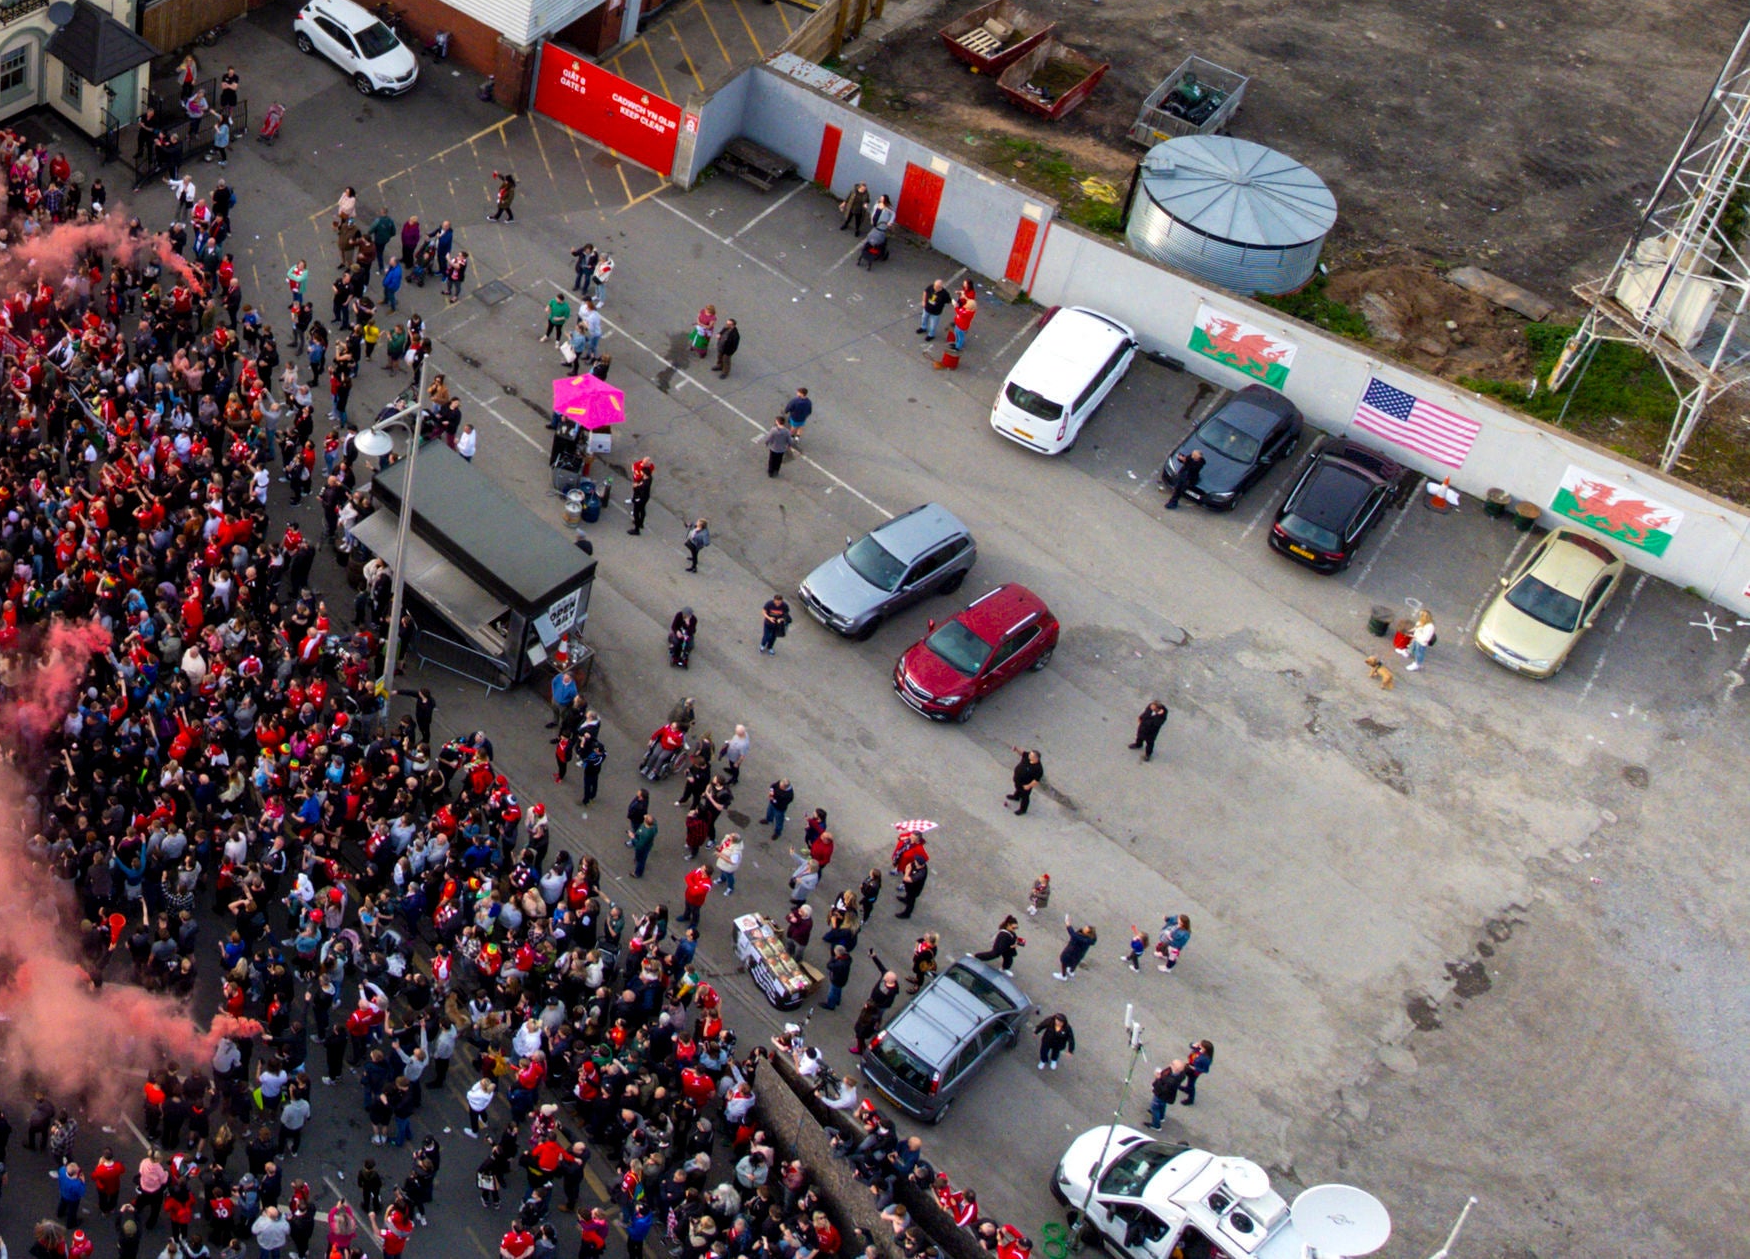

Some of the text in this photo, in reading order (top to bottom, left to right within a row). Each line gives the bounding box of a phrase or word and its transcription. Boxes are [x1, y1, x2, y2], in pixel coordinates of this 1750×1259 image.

[560, 77, 581, 92] GATE
[612, 93, 646, 114] CADWCH
[646, 110, 659, 121] YN
[658, 115, 676, 129] GLIR
[619, 106, 665, 133] KEEP CLEAR
[687, 120, 695, 132] 8
[550, 599, 576, 622] OPEN
[215, 1209, 228, 1218] 10
